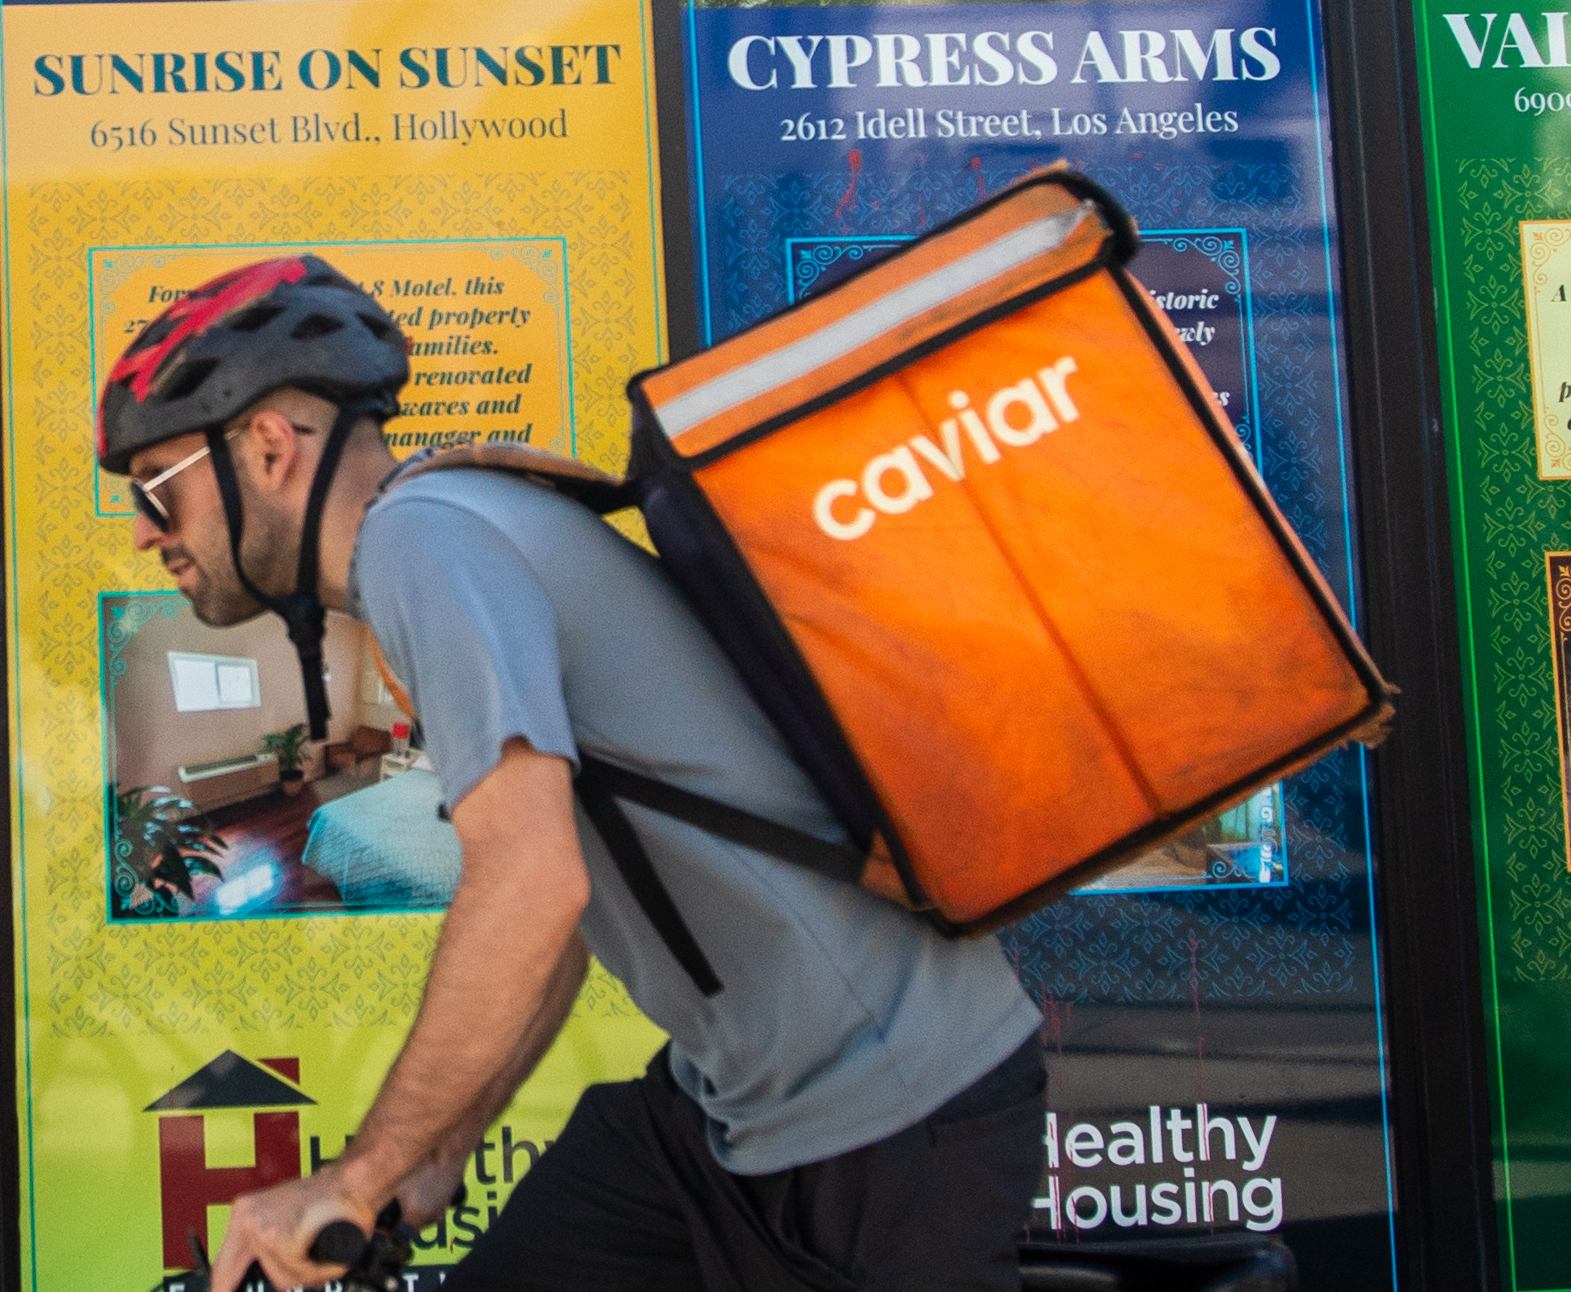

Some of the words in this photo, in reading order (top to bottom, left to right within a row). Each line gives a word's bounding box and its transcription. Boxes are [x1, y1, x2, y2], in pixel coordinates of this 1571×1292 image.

[33, 50, 283, 97] SUNRISE
[297, 48, 381, 91] ON
[398, 43, 621, 89] SUNSET
[727, 32, 1057, 91] CYPRESS
[1073, 26, 1282, 83] ARMS
[90, 120, 158, 151] 6516
[168, 117, 278, 146] Sunset
[291, 111, 381, 144] Blvd.,
[393, 107, 568, 147] Hollywood
[781, 112, 847, 142] 2612
[856, 107, 928, 140] Idell
[936, 109, 1043, 140] Street,
[1051, 107, 1108, 136] Los
[1114, 102, 1243, 140] Angeles
[427, 306, 531, 331] property
[414, 362, 533, 387] renovated
[813, 356, 1078, 541] caviar
